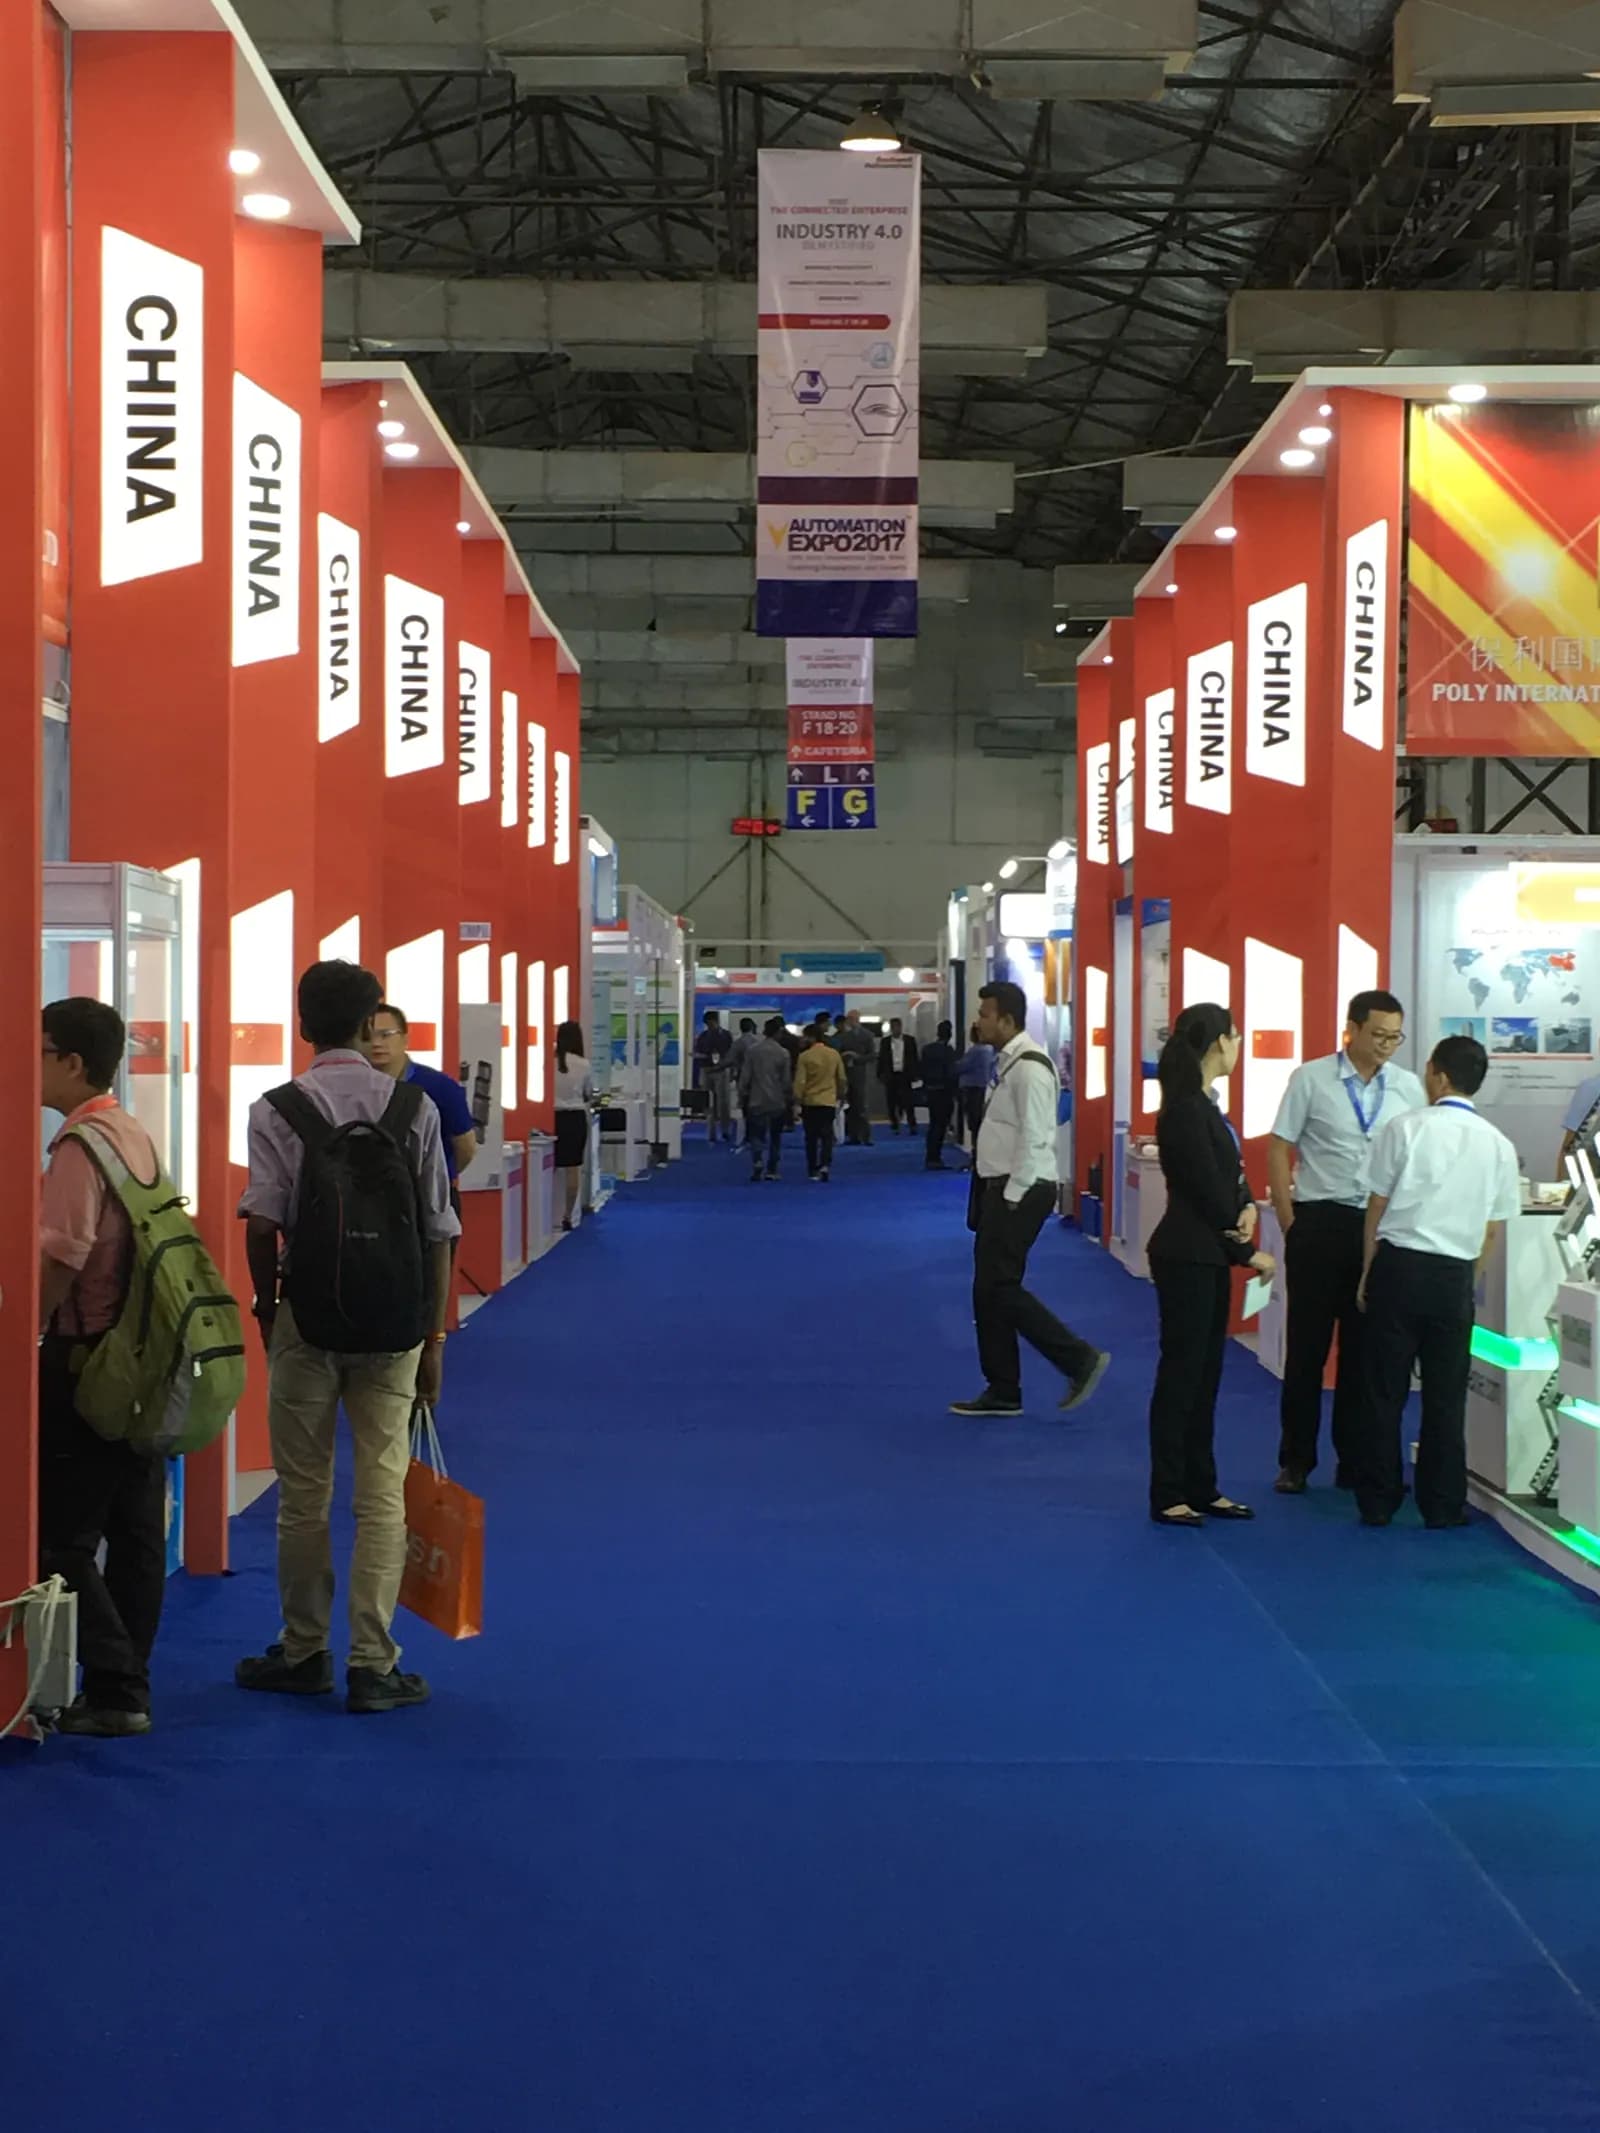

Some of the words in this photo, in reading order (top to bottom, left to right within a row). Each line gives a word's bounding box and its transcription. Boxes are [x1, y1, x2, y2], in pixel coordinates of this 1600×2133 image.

[776, 223, 870, 239] INDUSTRY
[874, 224, 903, 239] 4.0
[126, 294, 178, 524] CHINA
[248, 433, 282, 617] CHINA
[788, 518, 906, 533] AUTOMATION
[787, 533, 906, 552] EXPO2017
[329, 554, 349, 701] CHINA
[1354, 561, 1375, 707] CHINA
[400, 614, 429, 743] CHINA
[1263, 620, 1292, 748] CHINA
[1432, 683, 1489, 701] POLY
[1496, 683, 1600, 702] INTERNAT
[801, 710, 837, 719] STAND
[802, 721, 812, 735] F
[815, 721, 858, 735] 18-20
[1200, 670, 1225, 783] CHINA
[803, 746, 867, 756] CAFETERIA
[823, 765, 839, 783] L
[796, 790, 817, 815] F
[842, 789, 868, 815] G
